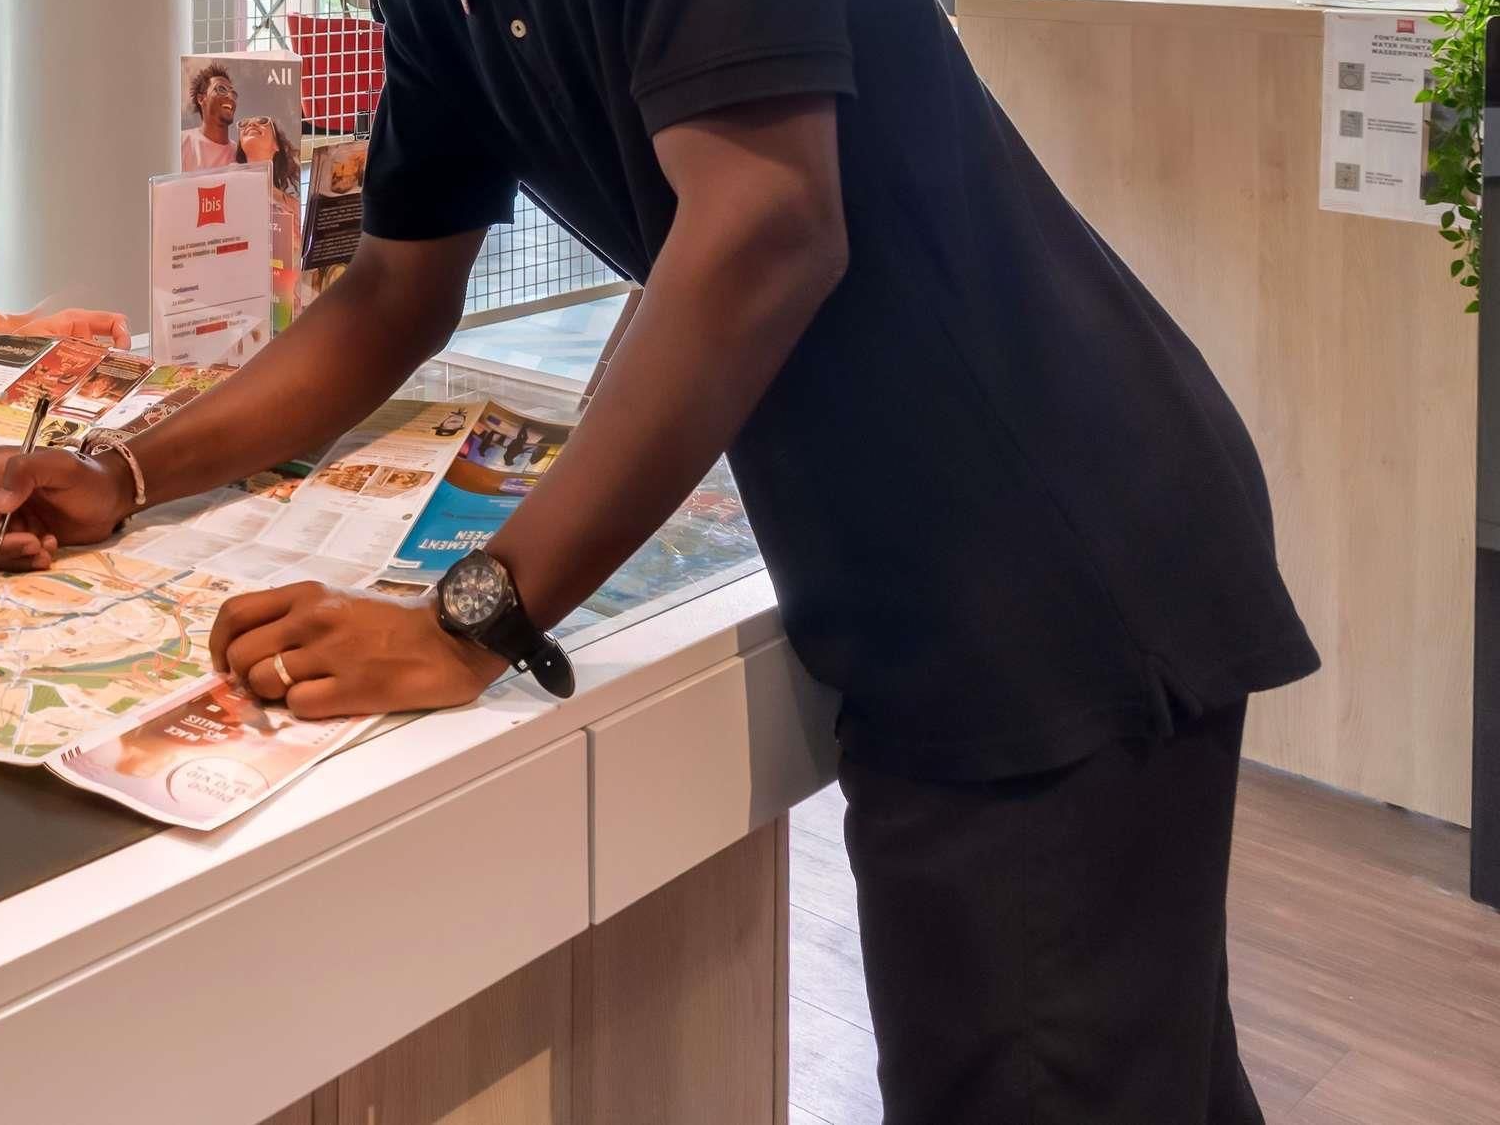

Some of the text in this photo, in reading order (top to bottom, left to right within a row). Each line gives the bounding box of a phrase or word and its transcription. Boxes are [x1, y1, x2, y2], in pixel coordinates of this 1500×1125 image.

[1374, 35, 1412, 43] FONTAINE
[267, 68, 292, 85] All
[201, 197, 222, 213] ibis
[163, 725, 201, 742] PLACE
